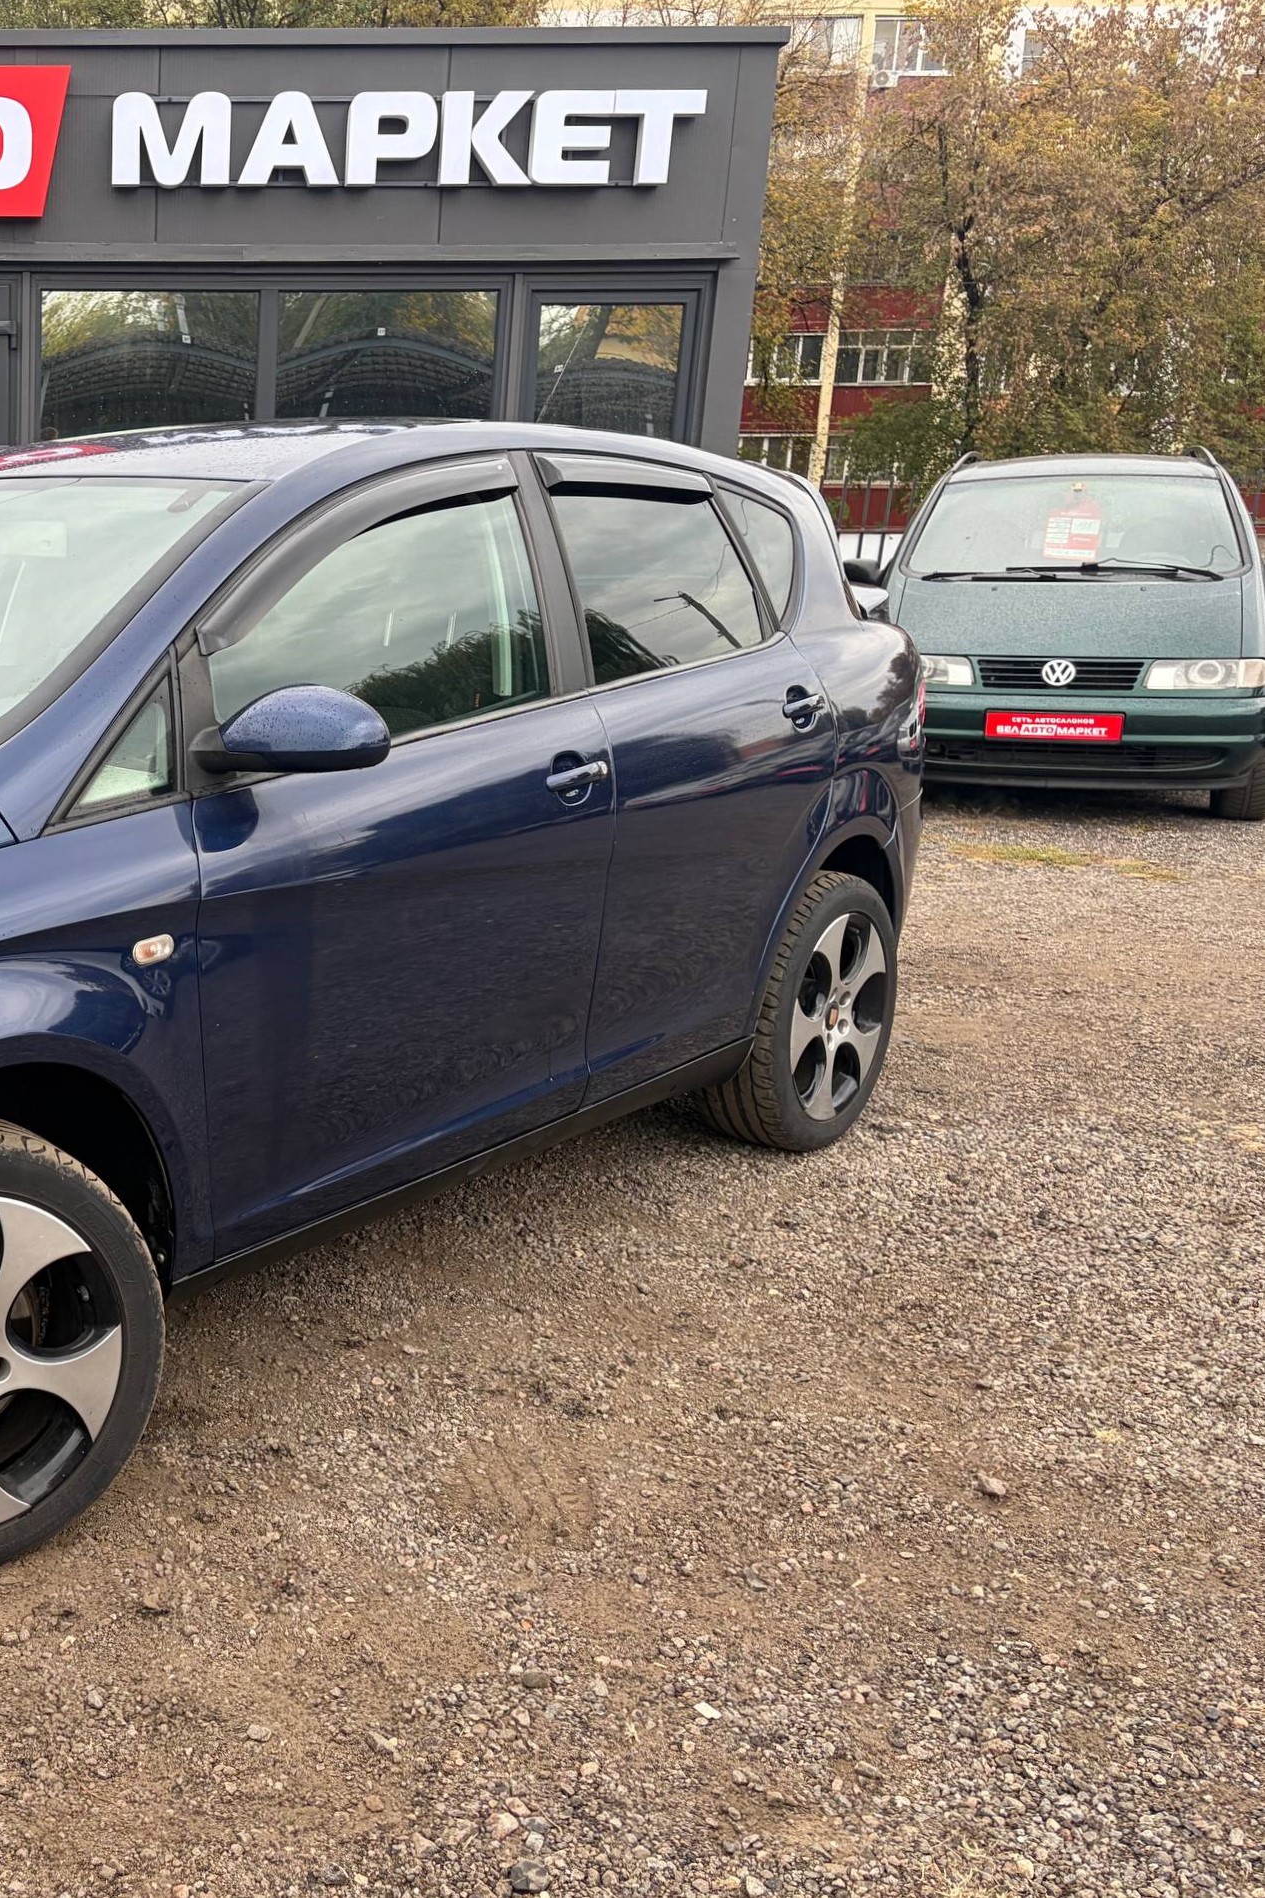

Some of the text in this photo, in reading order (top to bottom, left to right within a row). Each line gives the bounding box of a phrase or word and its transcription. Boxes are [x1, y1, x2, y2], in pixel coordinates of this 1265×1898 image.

[111, 89, 708, 189] МАРКЕТ
[1011, 716, 1095, 725] СЕТЬ АВТОСАЛОНОВ
[996, 725, 1109, 736] БЕЛ АВТО МАРКЕТ
